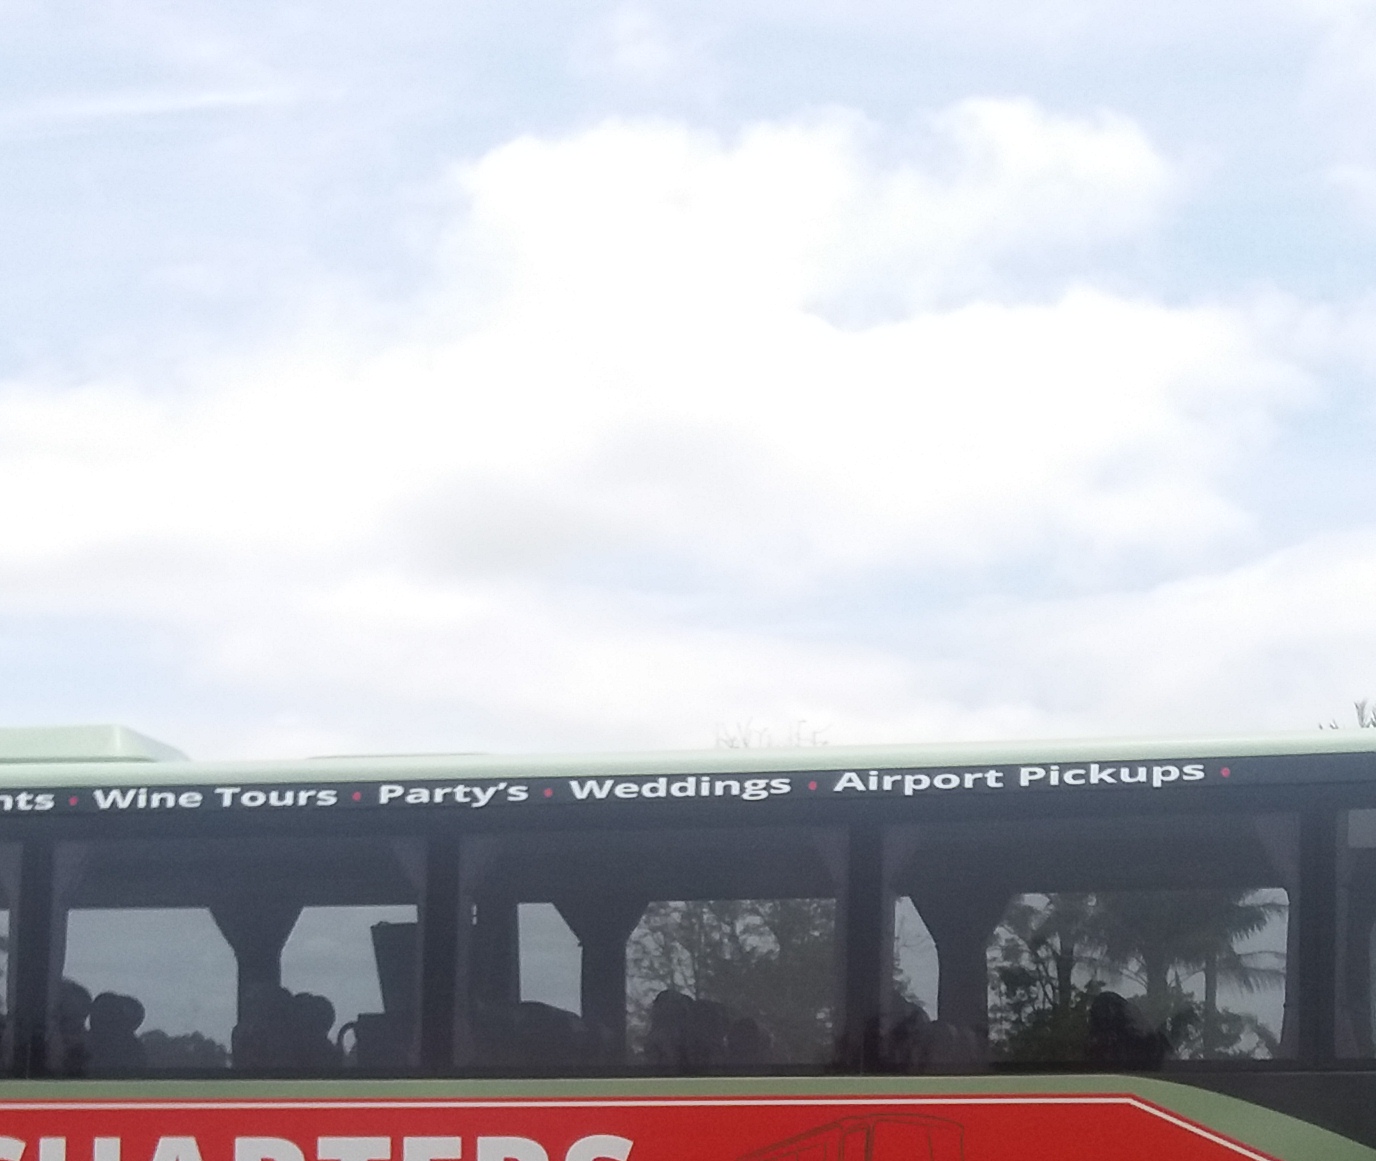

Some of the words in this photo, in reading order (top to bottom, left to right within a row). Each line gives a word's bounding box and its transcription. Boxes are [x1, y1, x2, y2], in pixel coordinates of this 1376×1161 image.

[94, 787, 204, 810] Wine
[214, 786, 339, 809] Tours
[378, 781, 530, 808] Party's
[568, 773, 793, 801] Weddings
[832, 766, 1005, 797] Airport
[1018, 759, 1206, 789] Pickups
